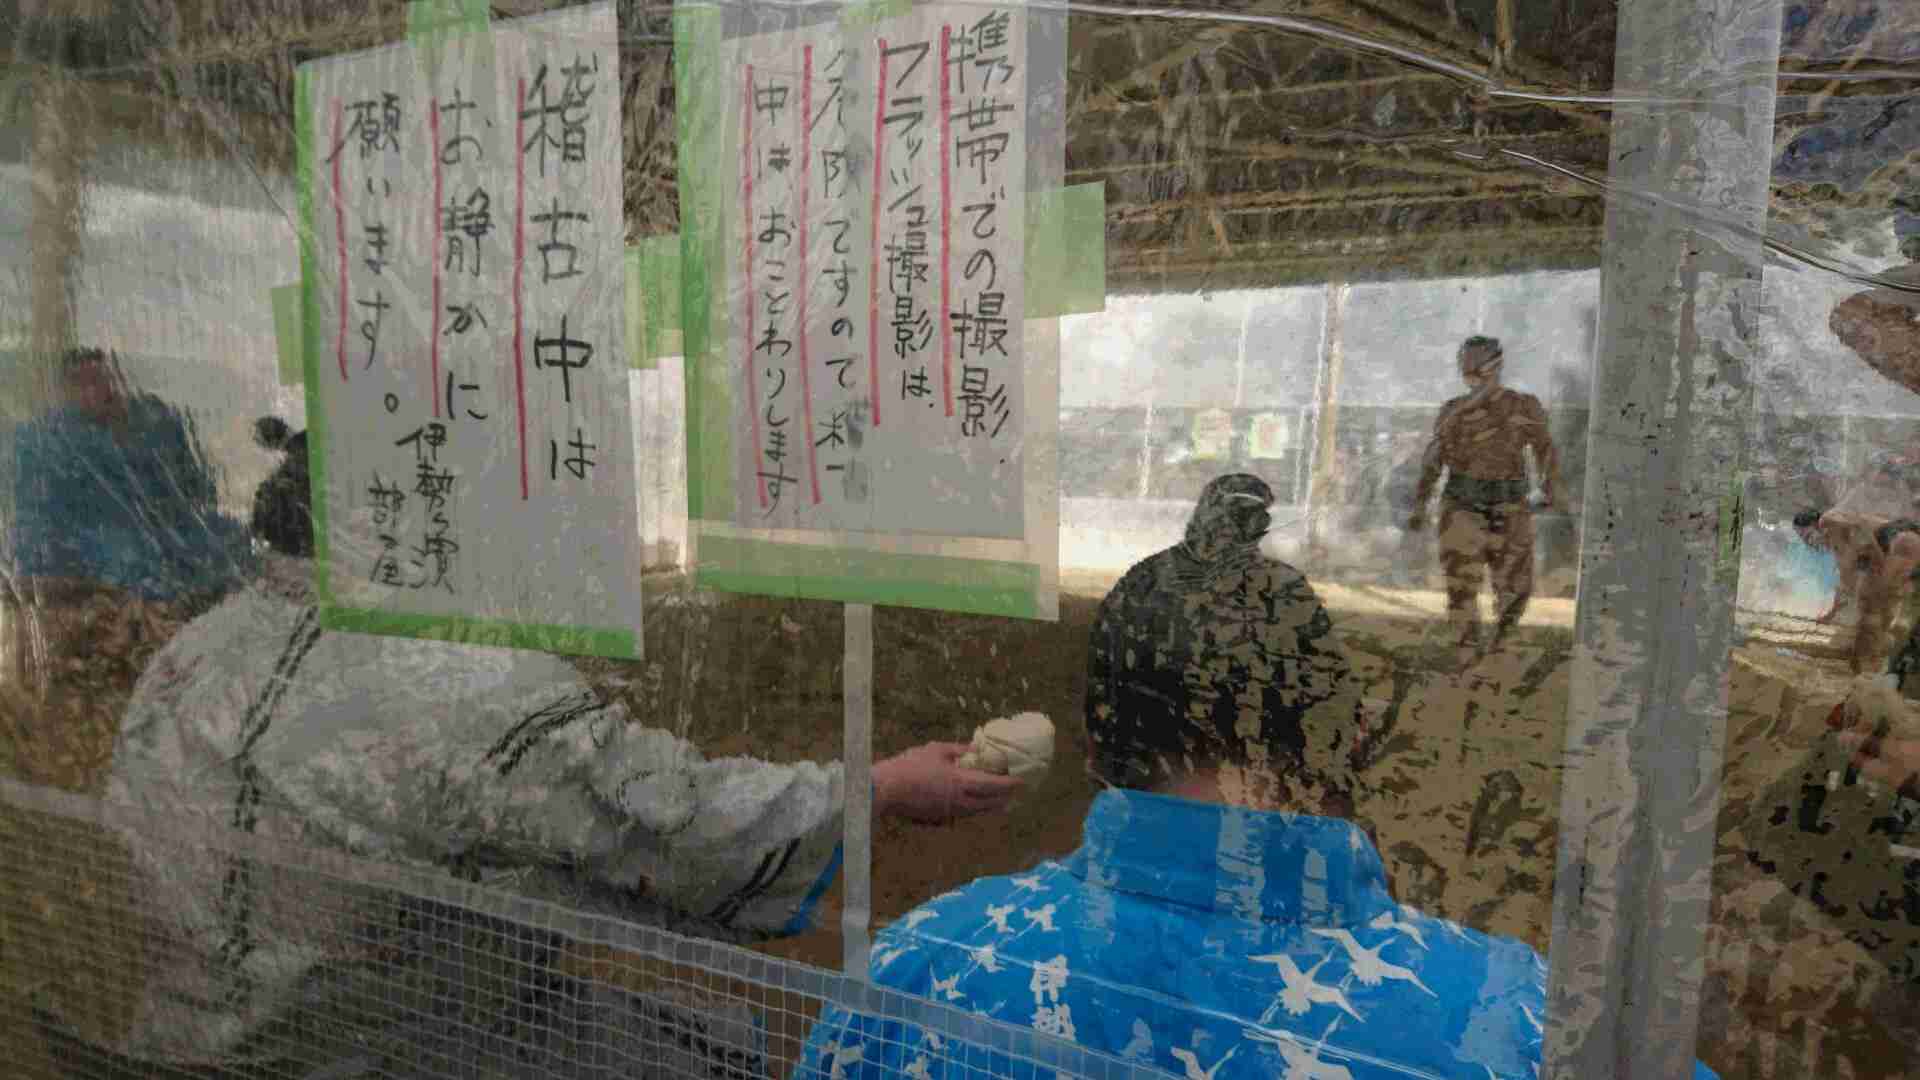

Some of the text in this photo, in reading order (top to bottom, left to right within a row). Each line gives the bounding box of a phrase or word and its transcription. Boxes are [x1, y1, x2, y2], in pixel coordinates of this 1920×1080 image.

[438, 88, 491, 420] お静かに
[519, 50, 598, 480] 稽古中は
